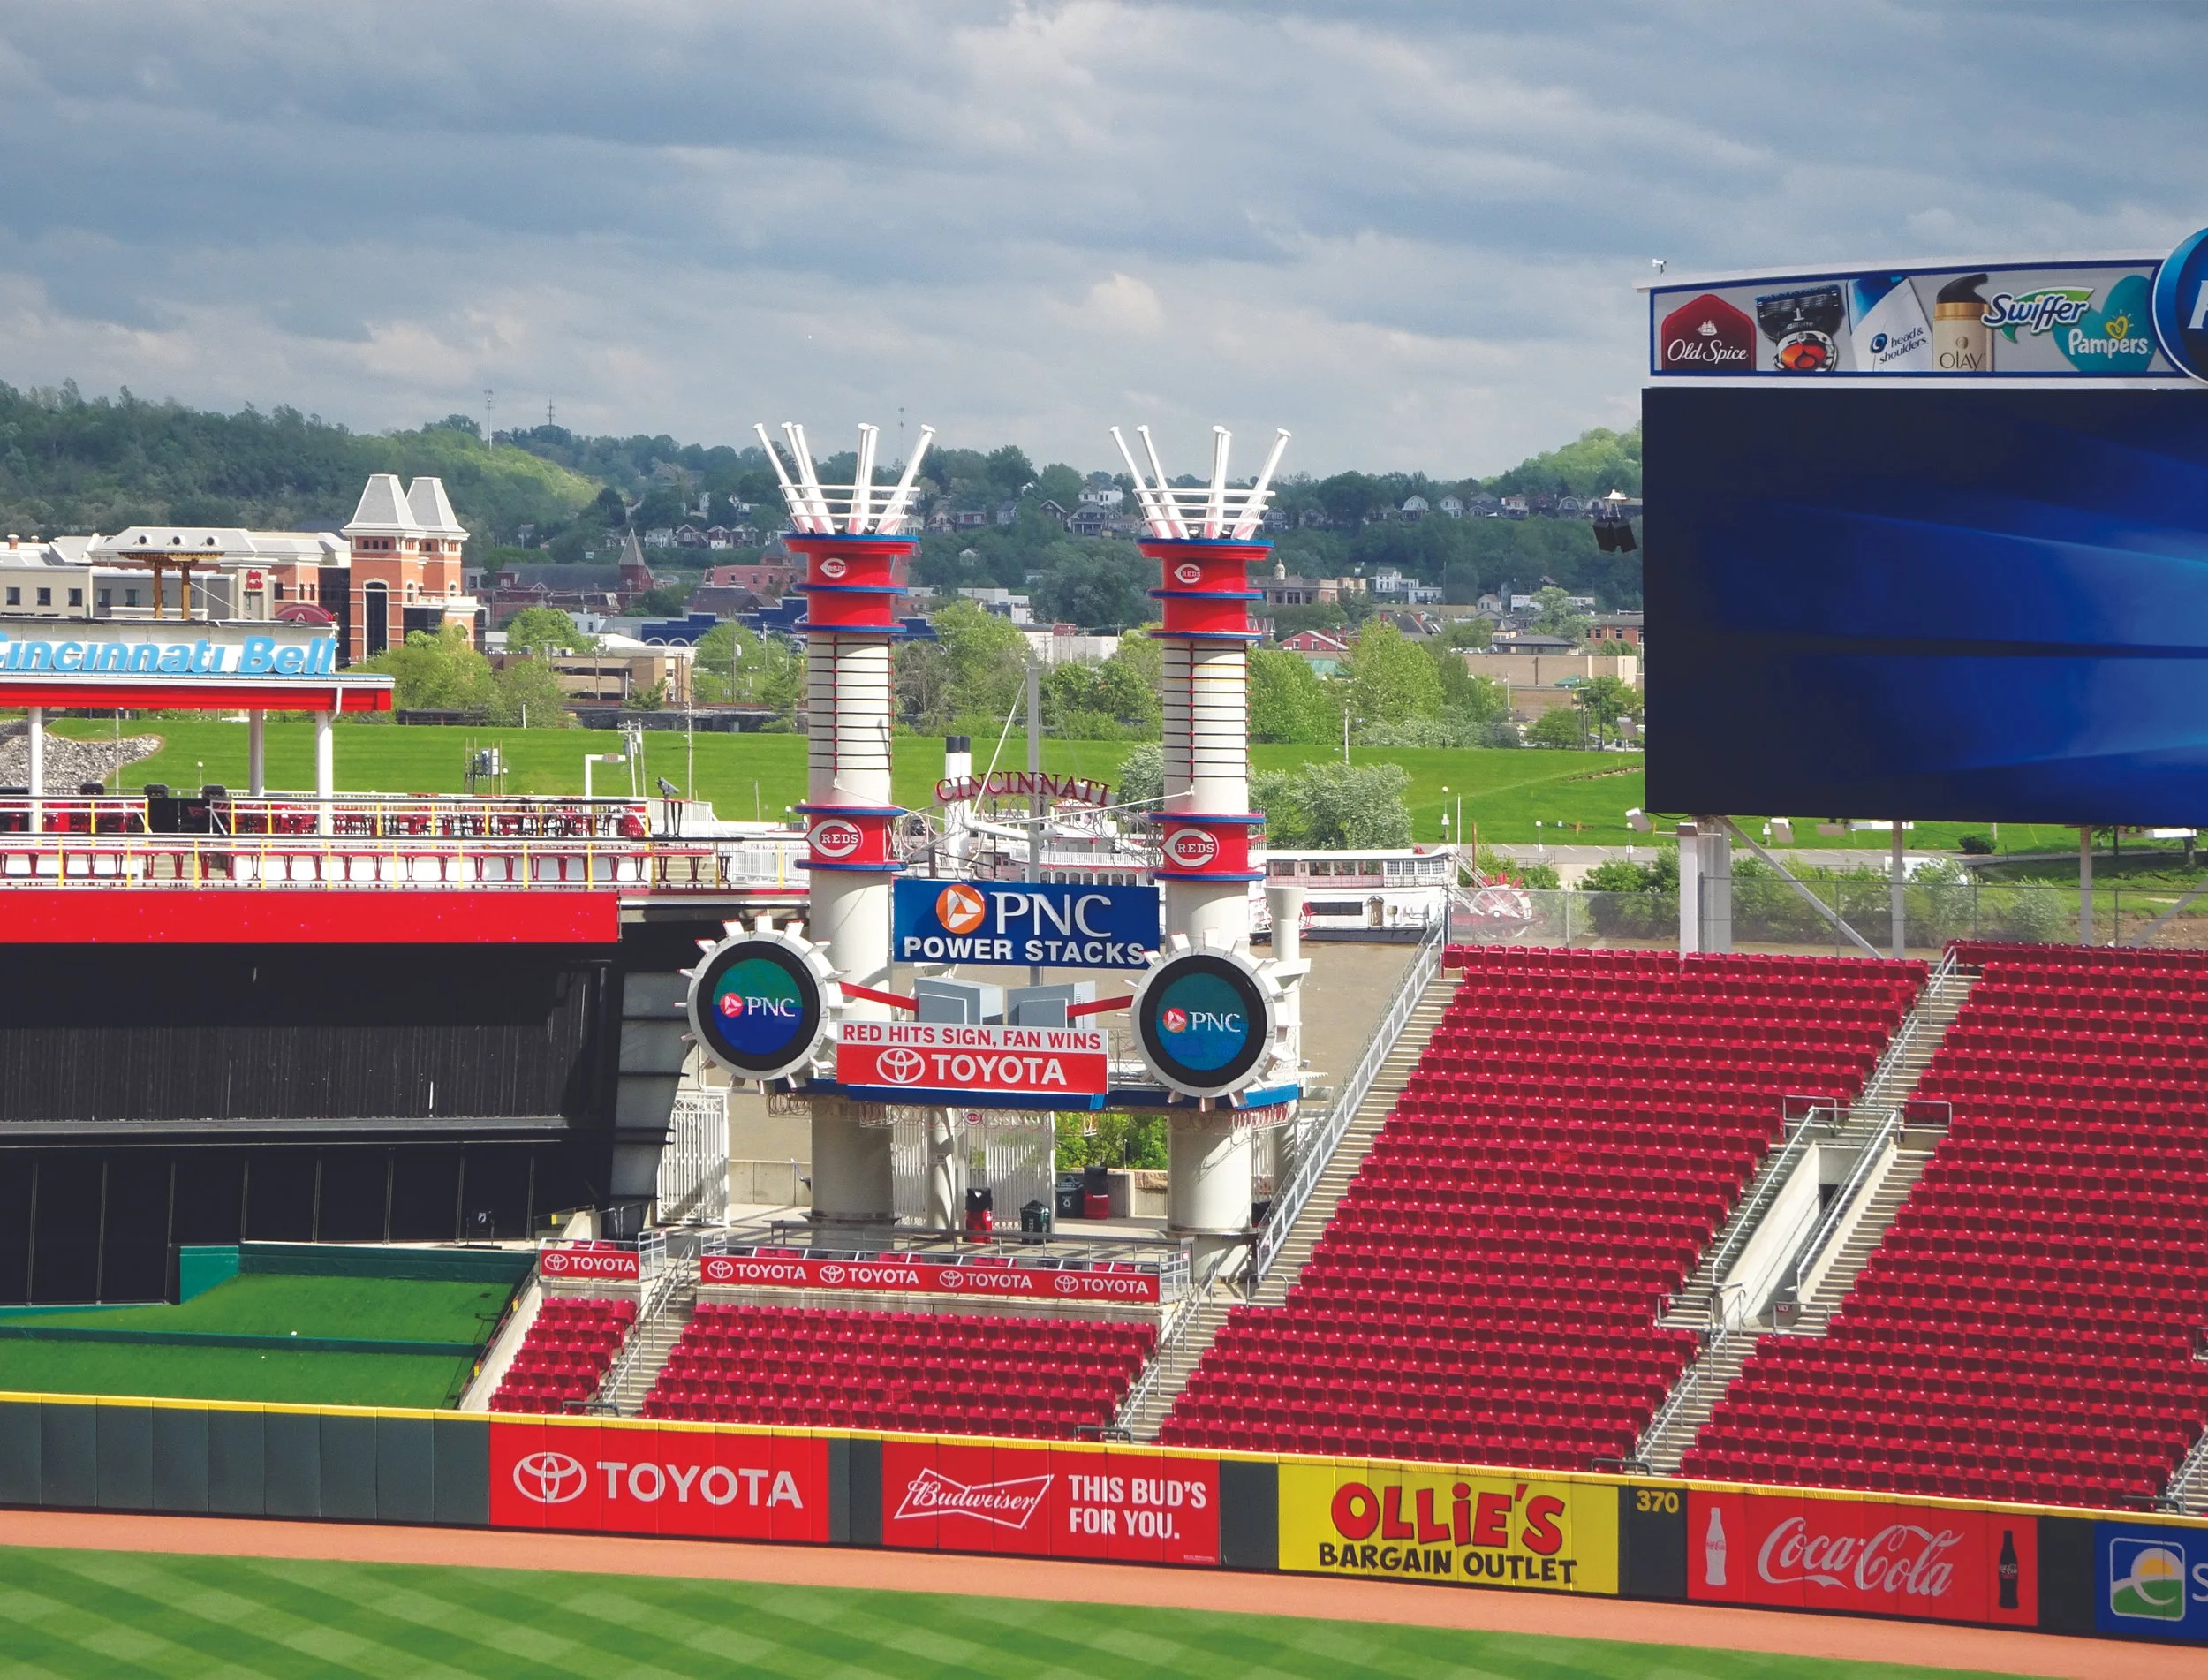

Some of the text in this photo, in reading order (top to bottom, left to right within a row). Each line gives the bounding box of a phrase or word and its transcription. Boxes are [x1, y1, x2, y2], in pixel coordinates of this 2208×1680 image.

[1981, 292, 2090, 334] Swiffer
[1879, 337, 1927, 364] shoulders
[1891, 327, 1924, 348] head &
[2068, 328, 2148, 358] Pampers
[1667, 338, 1748, 366] Old Spice
[238, 635, 336, 674] Bell
[935, 771, 1111, 806] CINCINNATI
[821, 834, 858, 844] REDS
[1176, 844, 1214, 853] REDS
[990, 891, 1112, 937] PNC
[904, 936, 1146, 965] POWER STACKS
[745, 996, 795, 1017] PNC
[1190, 1011, 1241, 1033] PNC
[843, 1024, 1101, 1050] RED HITS SIGN, FAN WINS
[931, 1053, 1067, 1086] TOYOTA
[571, 1256, 637, 1272] TOYOTA
[736, 1263, 806, 1280] TOYOTA
[848, 1268, 919, 1285] TOYOTA
[965, 1272, 1032, 1289] TOYOTA
[1081, 1278, 1149, 1295] TOYOTA
[596, 1461, 804, 1509] TOYOTA
[907, 1479, 1040, 1510] Budweiser
[1068, 1474, 1206, 1509] THIS BUD'S
[1636, 1489, 1679, 1513] 370
[1069, 1507, 1180, 1540] FOR YOU.
[1318, 1541, 1578, 1584] BARGAIN OUTLET
